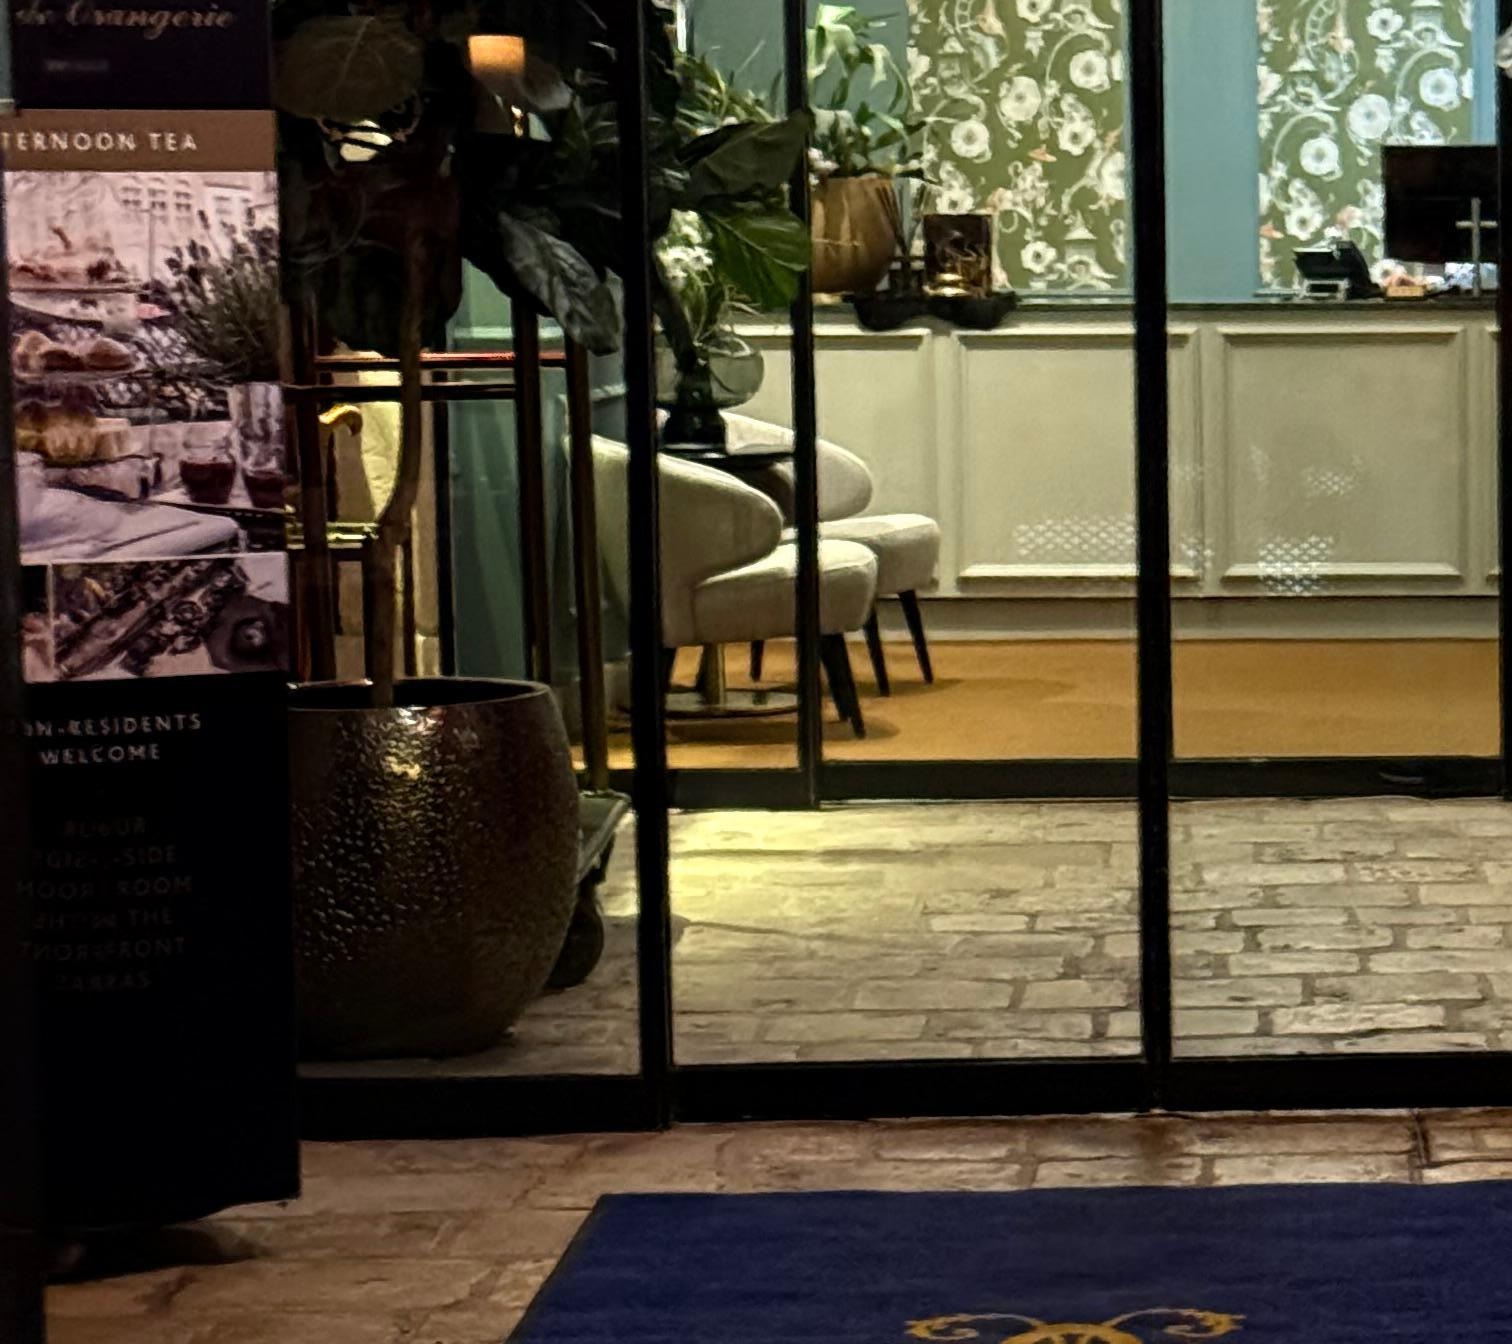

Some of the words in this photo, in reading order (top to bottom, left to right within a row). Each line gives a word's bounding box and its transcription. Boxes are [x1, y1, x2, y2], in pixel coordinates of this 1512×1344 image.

[0, 131, 137, 152] TERNOON
[150, 132, 199, 152] TEA
[22, 712, 202, 738] N-RESIDENTS
[40, 743, 161, 766] WELCOME
